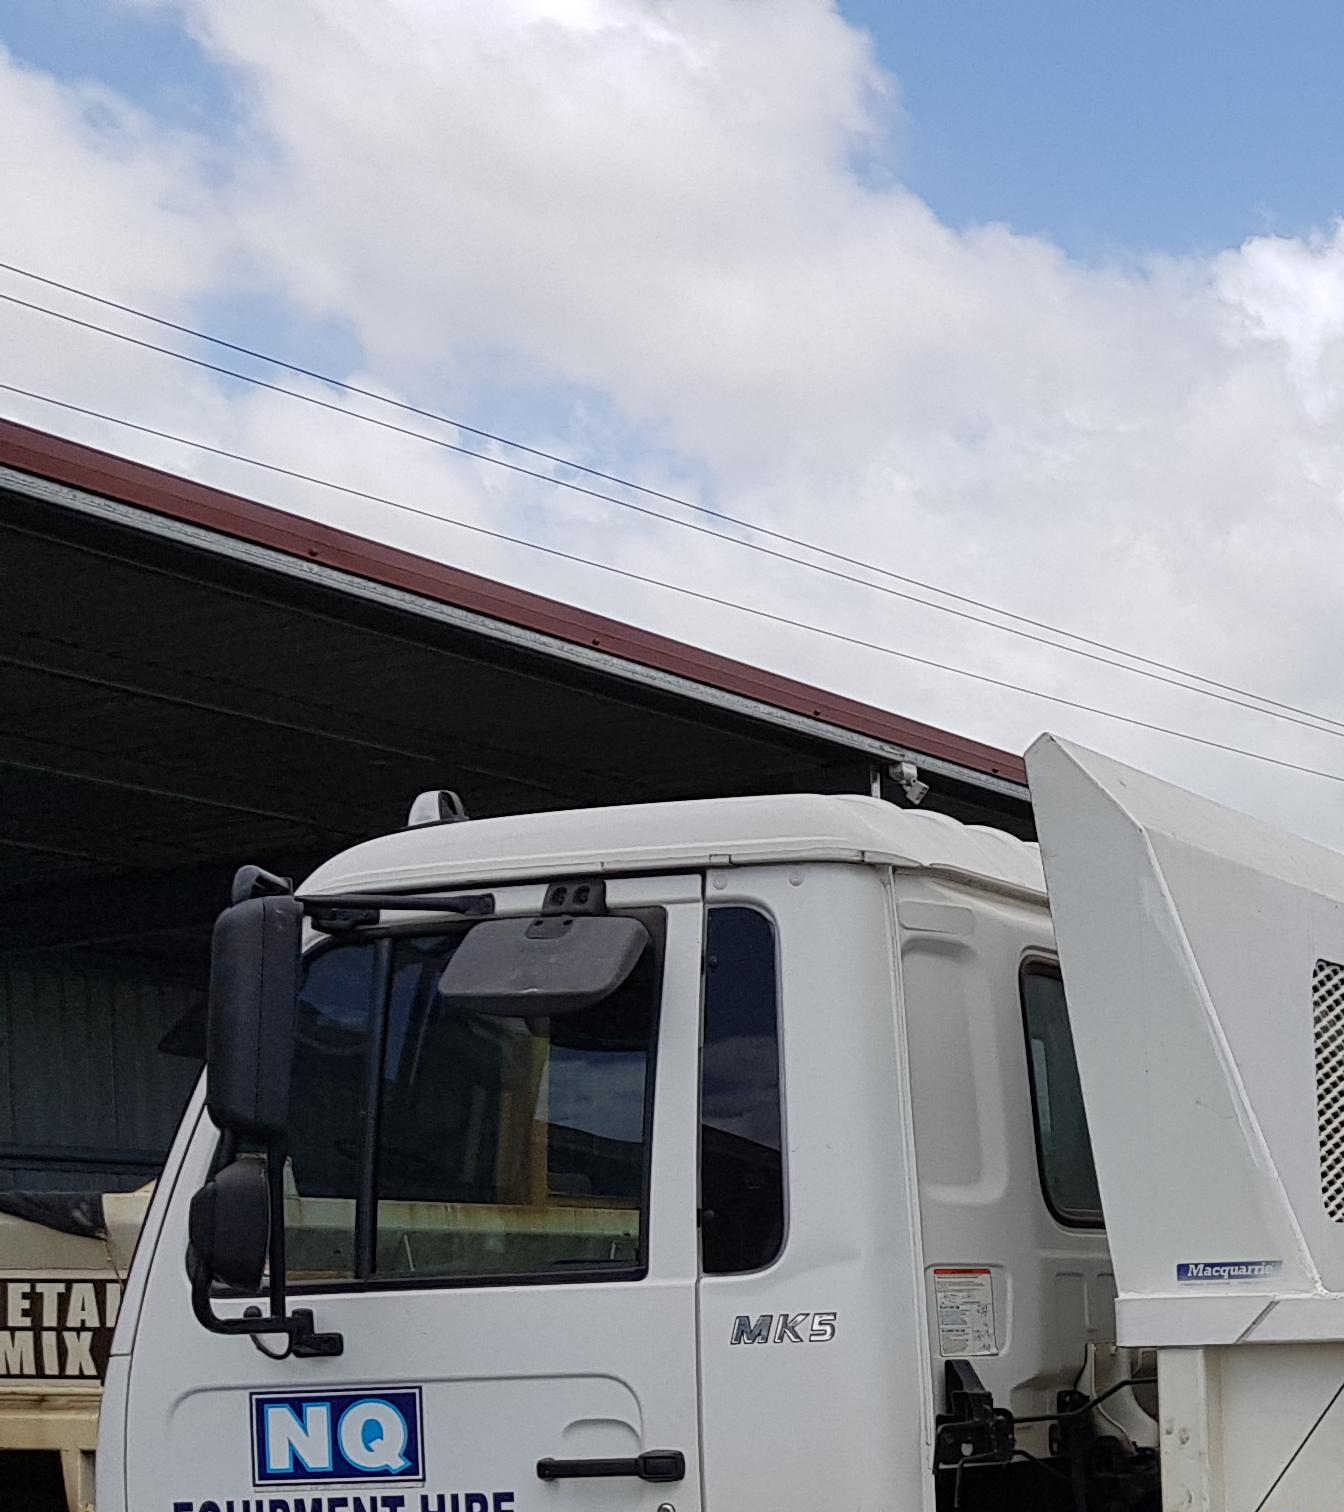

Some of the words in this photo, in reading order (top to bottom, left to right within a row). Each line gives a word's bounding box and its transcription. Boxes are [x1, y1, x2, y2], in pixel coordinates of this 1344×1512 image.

[7, 1282, 121, 1328] ETA
[730, 1312, 837, 1345] MK5
[0, 1331, 98, 1376] MIX
[263, 1398, 412, 1474] NQ
